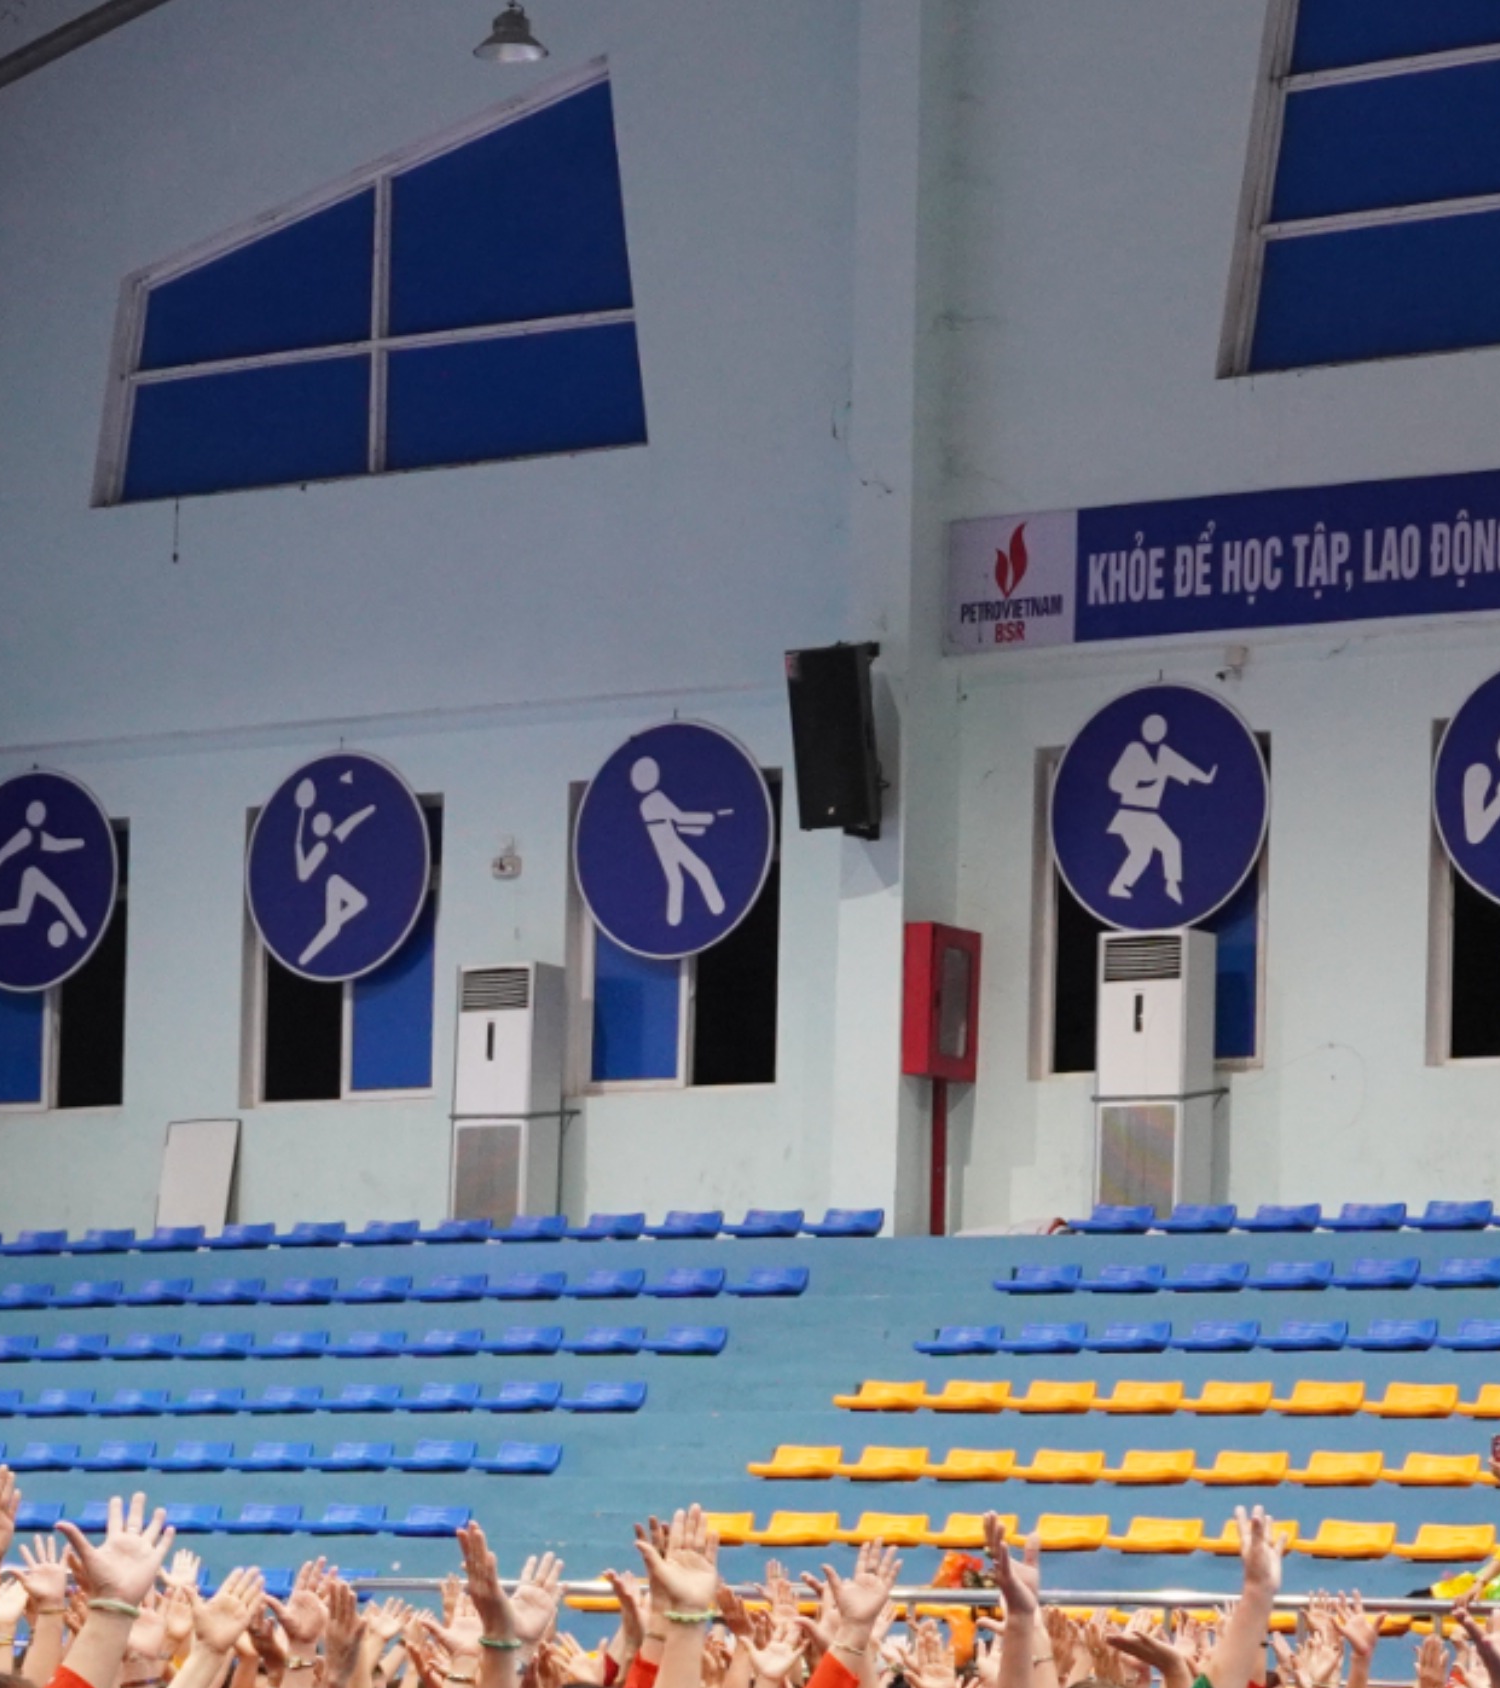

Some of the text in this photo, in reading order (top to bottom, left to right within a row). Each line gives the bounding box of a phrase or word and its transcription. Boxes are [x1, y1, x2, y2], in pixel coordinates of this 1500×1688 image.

[1088, 530, 1166, 605] KHỎE
[1174, 520, 1216, 598] ĐỂ
[1222, 537, 1284, 604] HỌC
[1293, 521, 1353, 599] TẬP,
[1363, 524, 1420, 583] LAO
[960, 594, 1062, 624] PETROVIETNAM
[995, 621, 1025, 643] BSR
